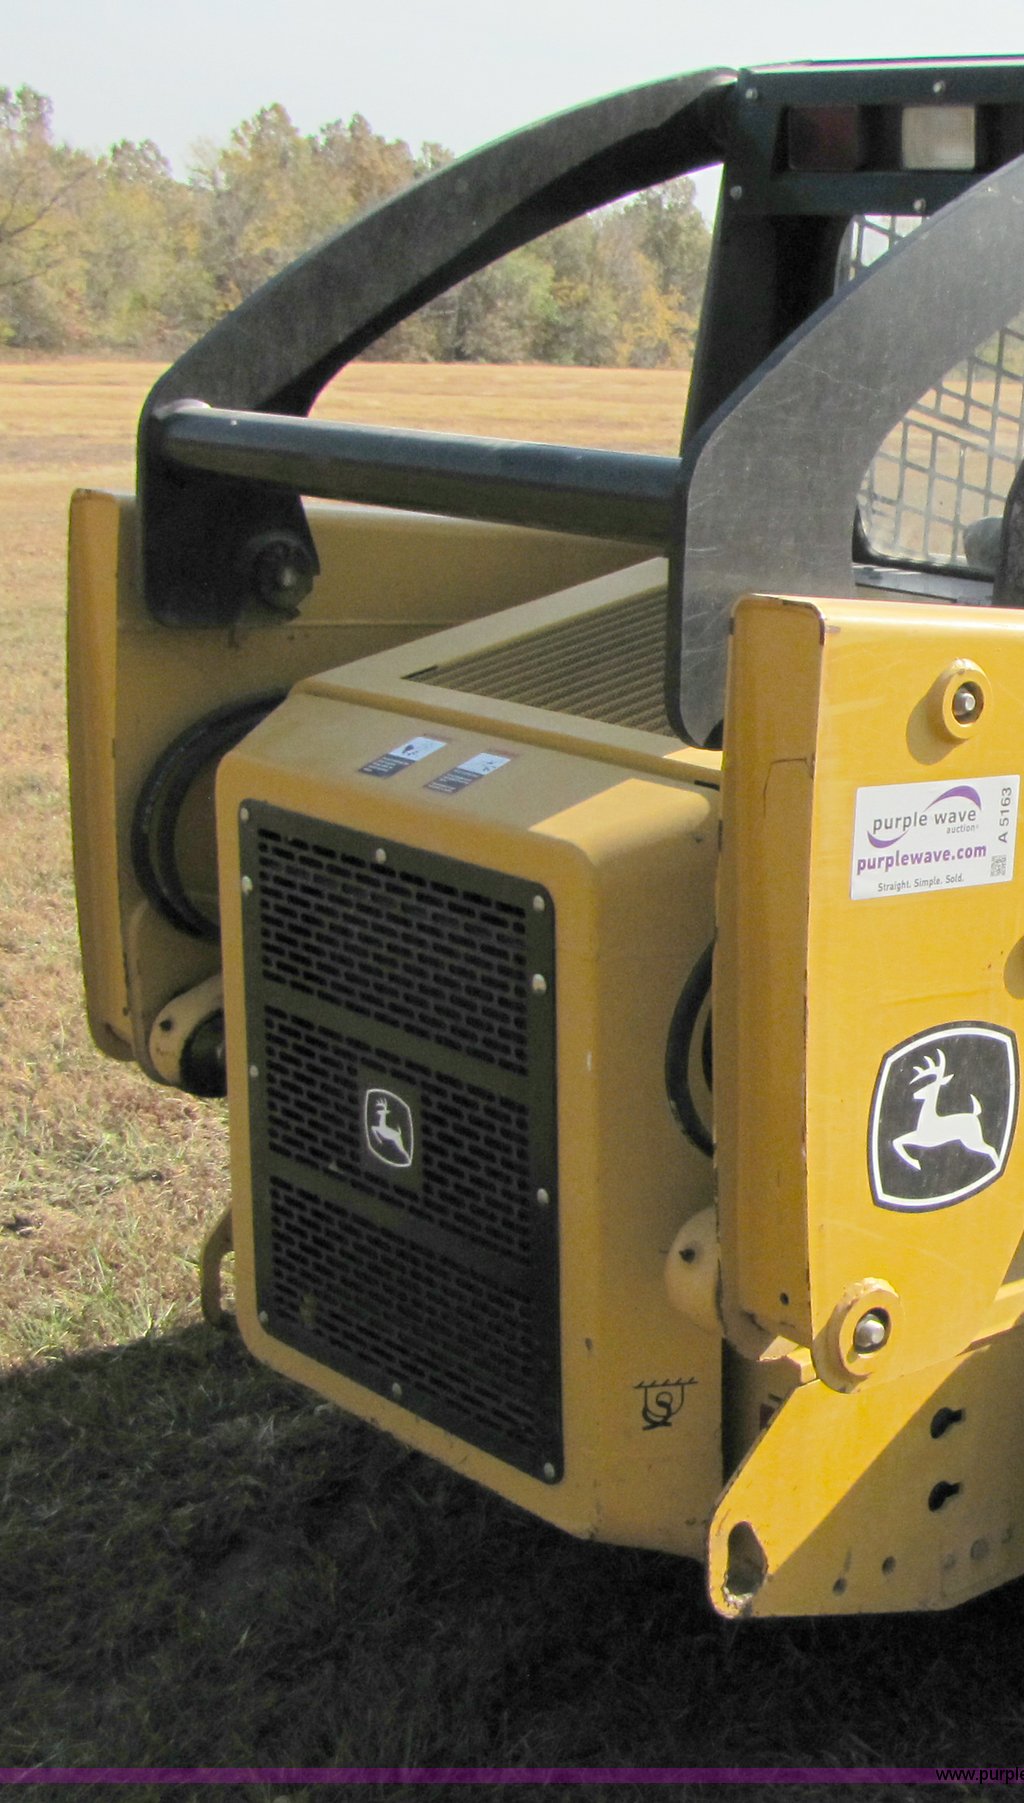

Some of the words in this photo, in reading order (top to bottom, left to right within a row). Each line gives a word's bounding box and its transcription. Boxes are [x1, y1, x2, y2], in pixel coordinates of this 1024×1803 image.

[1000, 787, 1012, 827] 5163
[873, 812, 927, 834] purple
[934, 809, 976, 825] wave
[998, 831, 1008, 843] A
[857, 845, 987, 875] purplewave.com
[878, 881, 911, 893] Straight.
[914, 878, 943, 888] Simple.
[946, 873, 964, 884] Sold.
